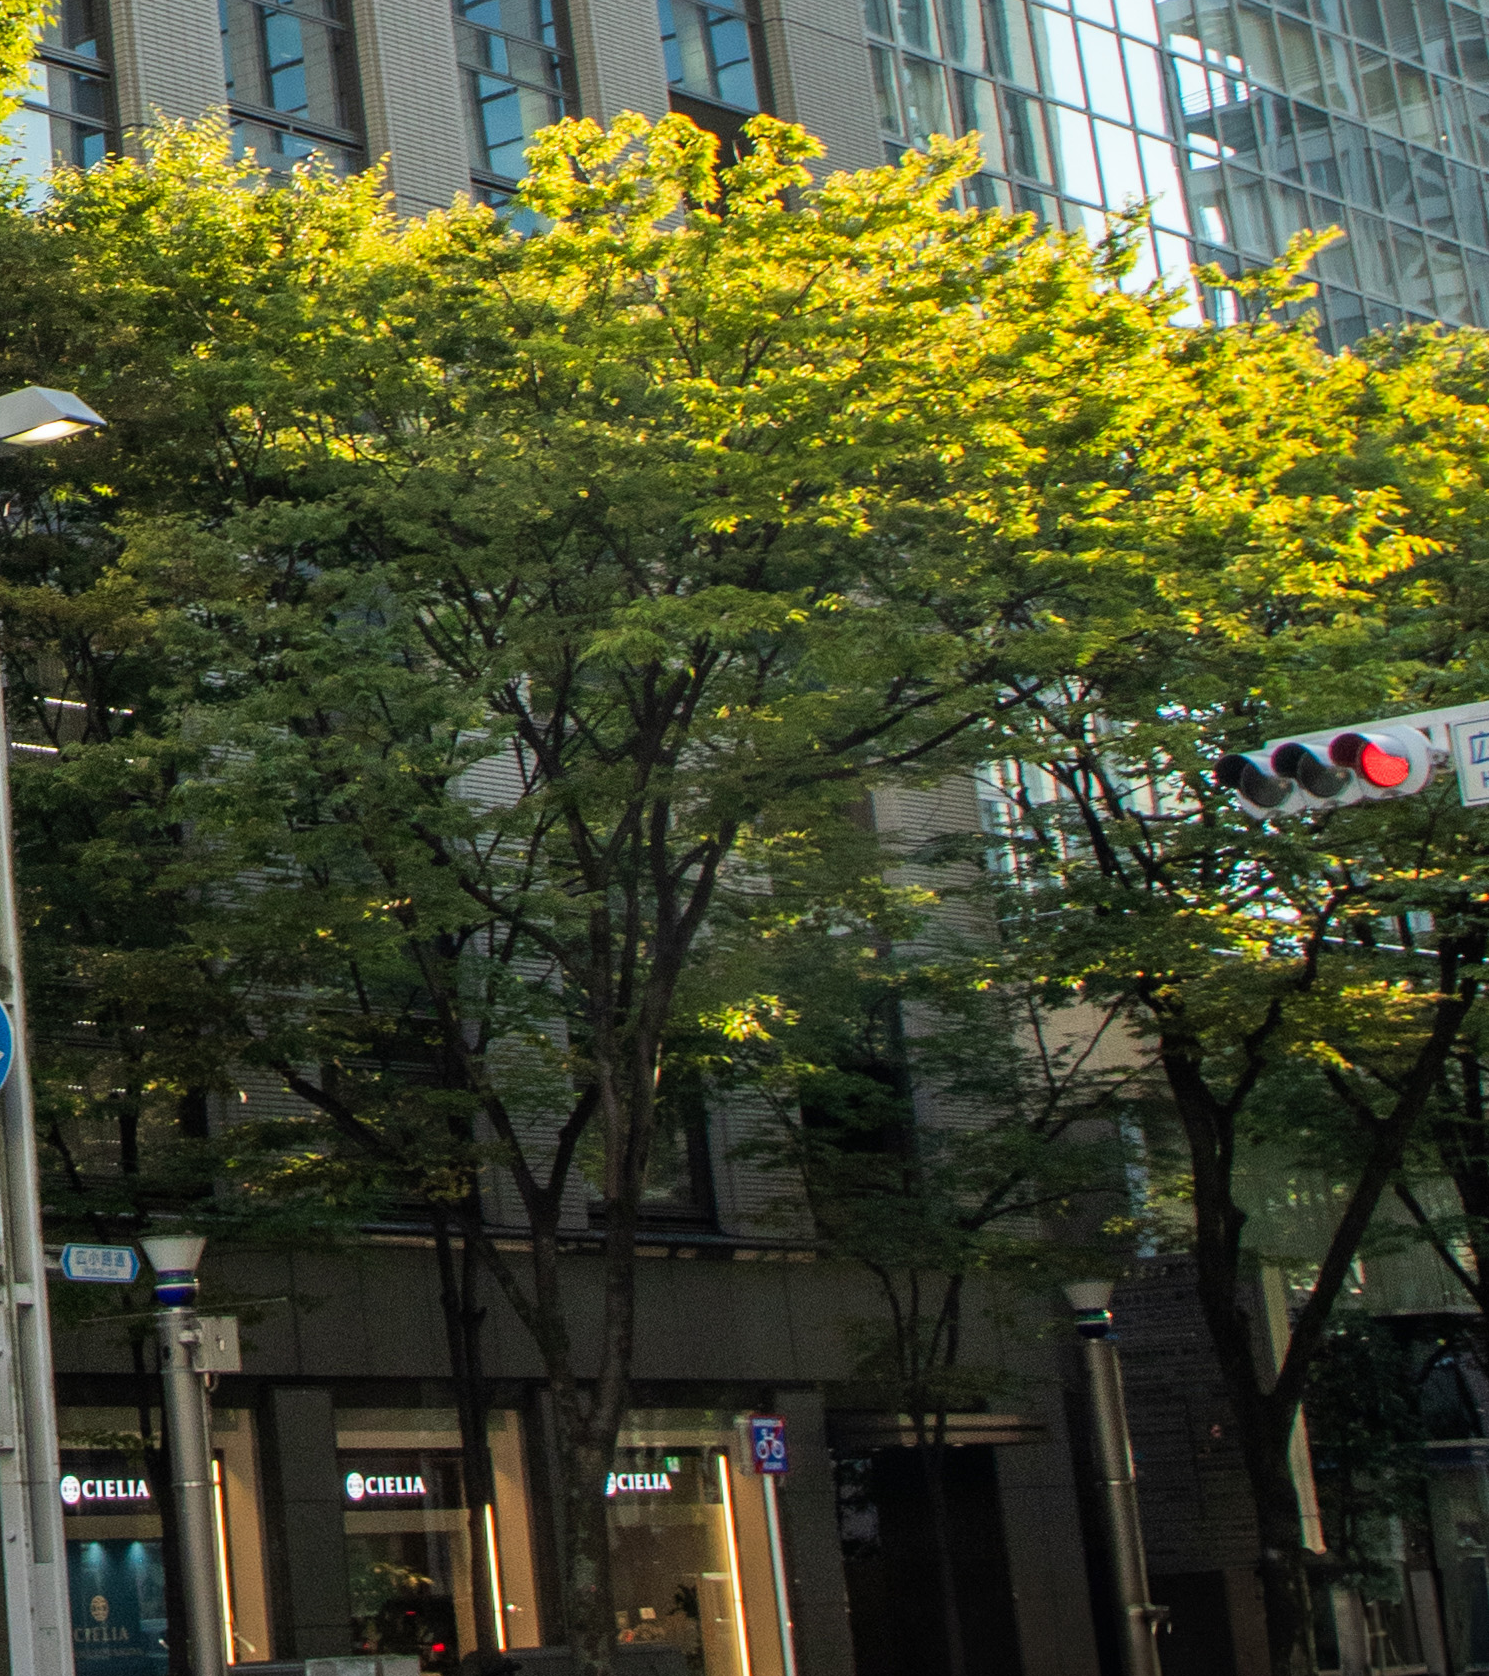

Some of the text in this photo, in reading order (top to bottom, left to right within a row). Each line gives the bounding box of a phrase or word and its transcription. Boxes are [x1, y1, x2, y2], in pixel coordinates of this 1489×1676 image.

[82, 1479, 151, 1498] CIELIA
[364, 1476, 427, 1494] CIELIA
[617, 1472, 672, 1491] CIELIA
